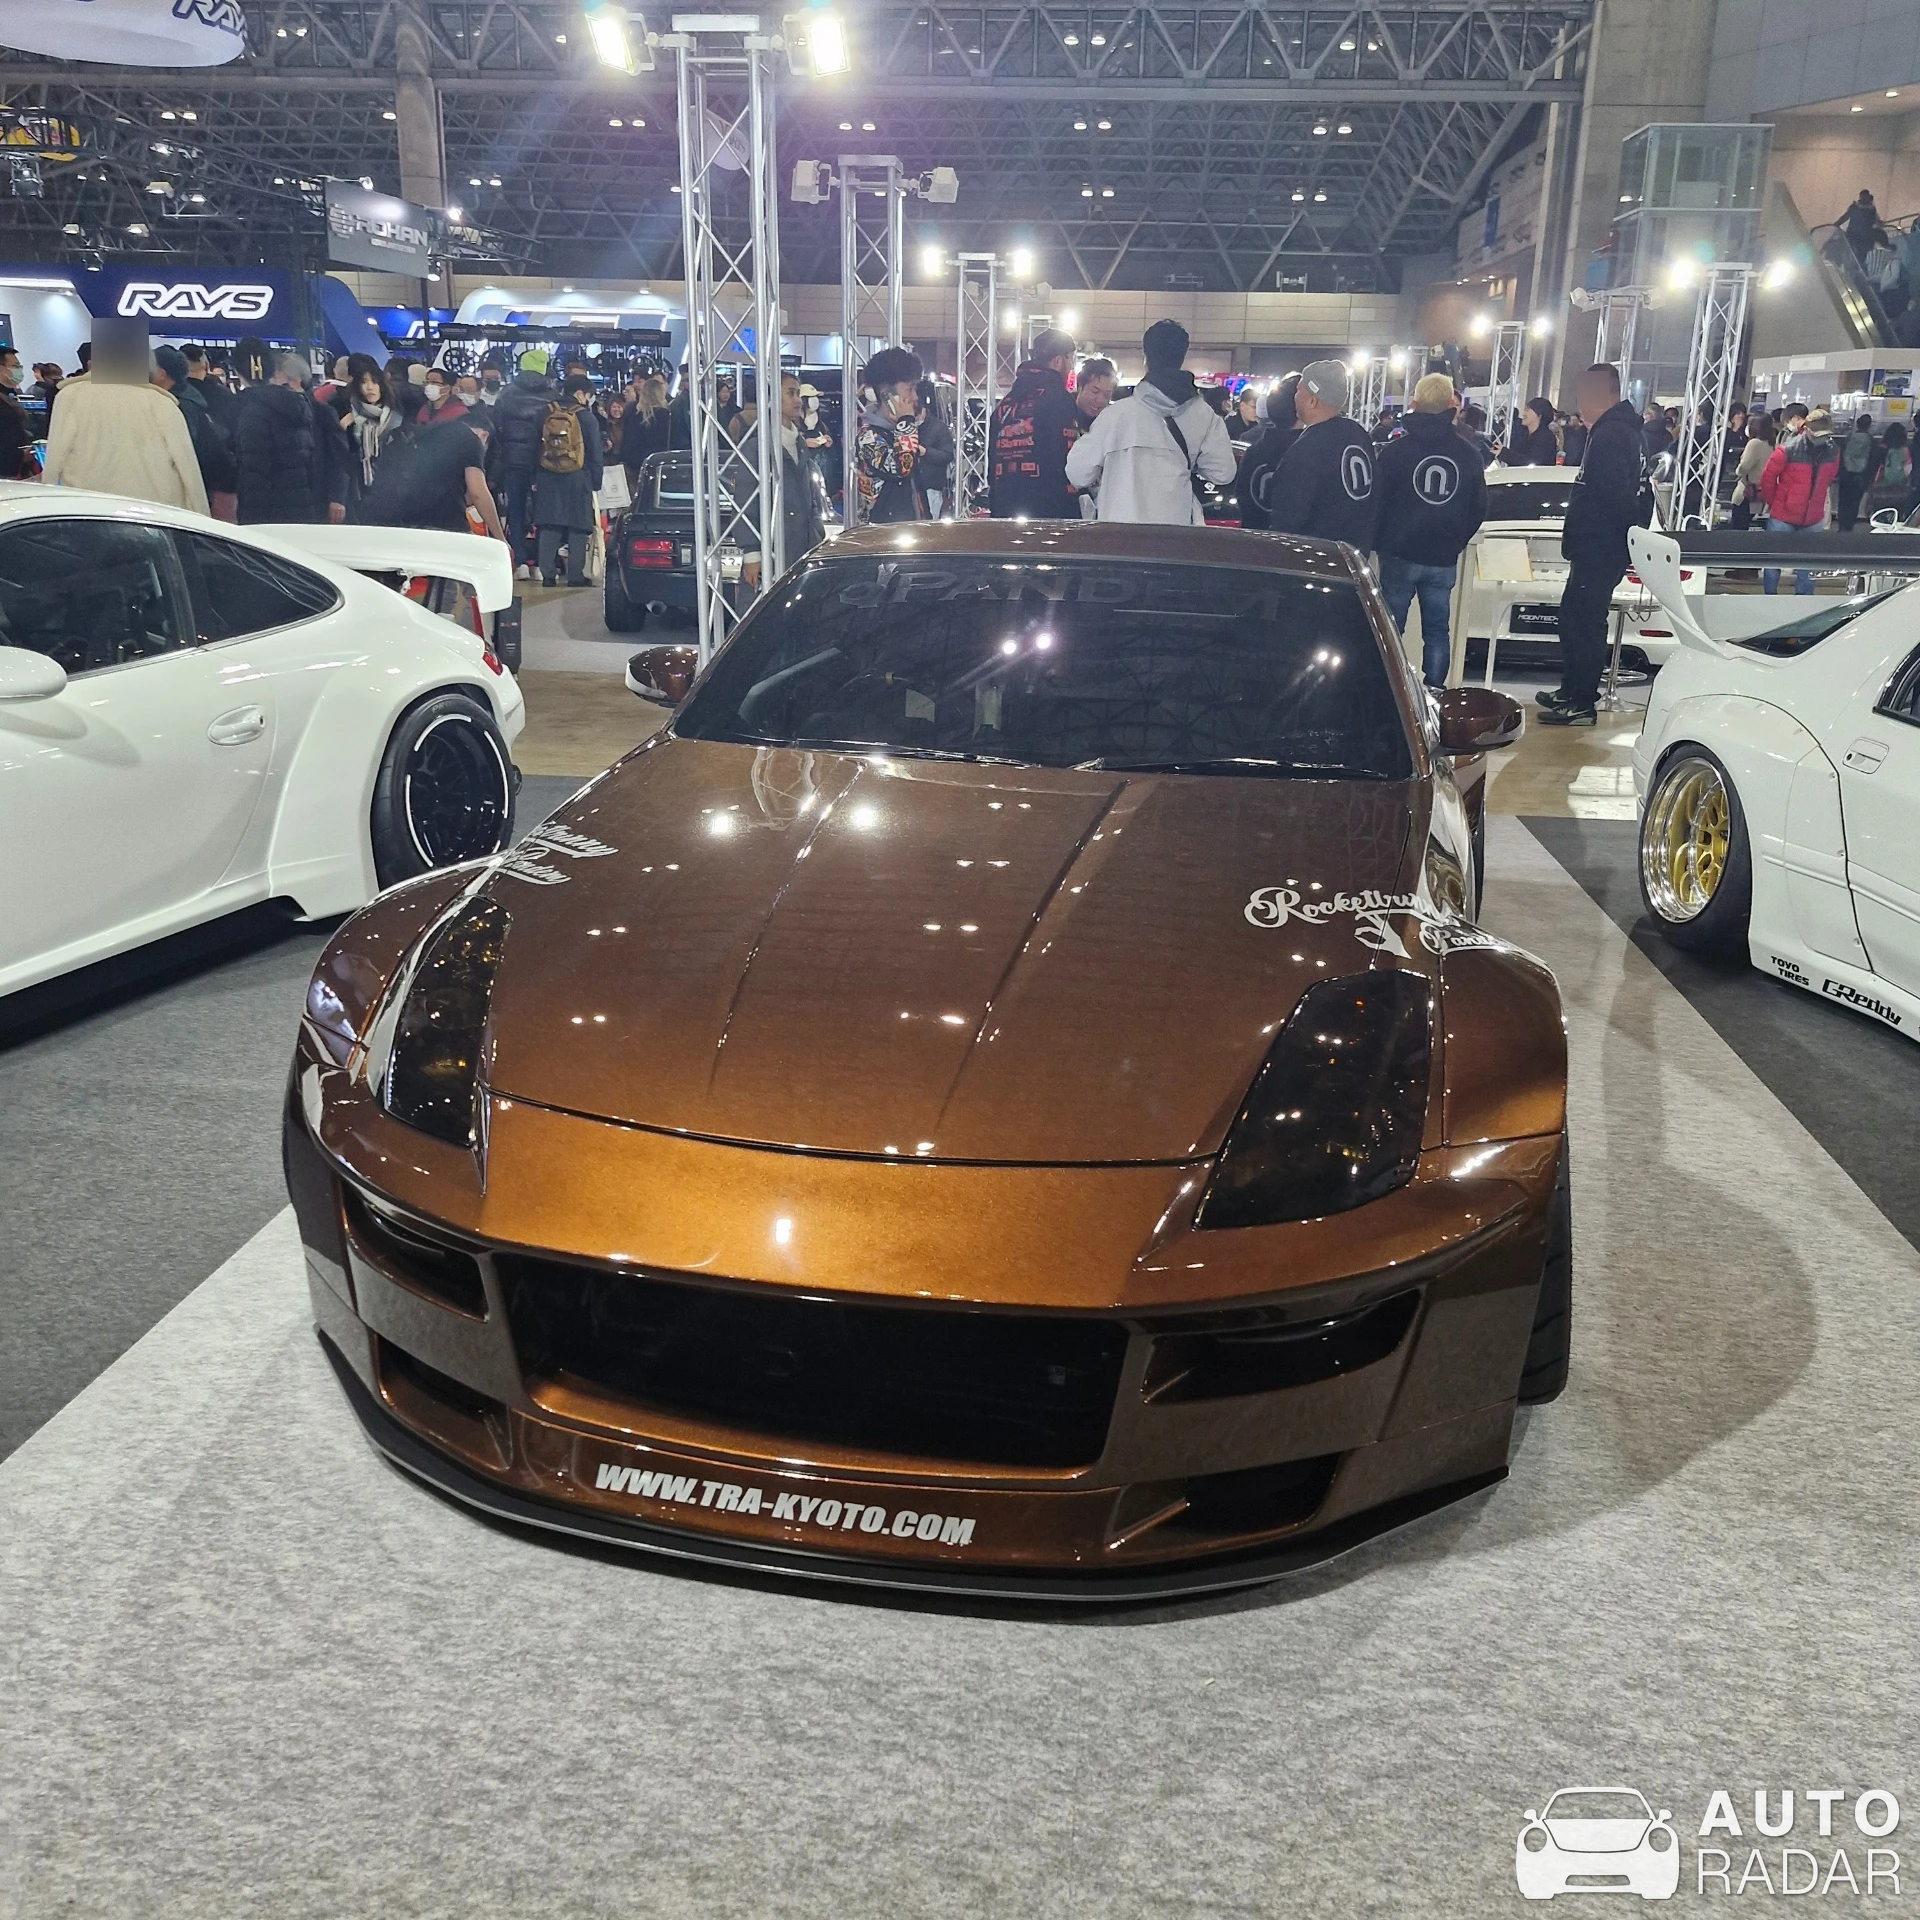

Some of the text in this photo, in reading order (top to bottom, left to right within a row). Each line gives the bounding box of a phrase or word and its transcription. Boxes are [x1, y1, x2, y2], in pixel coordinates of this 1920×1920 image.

[117, 282, 274, 320] RAYS
[1770, 956, 1800, 973] TOYO
[1778, 967, 1810, 987] TIRES
[595, 1463, 976, 1546] WWW.TRA-KYOTO.COM
